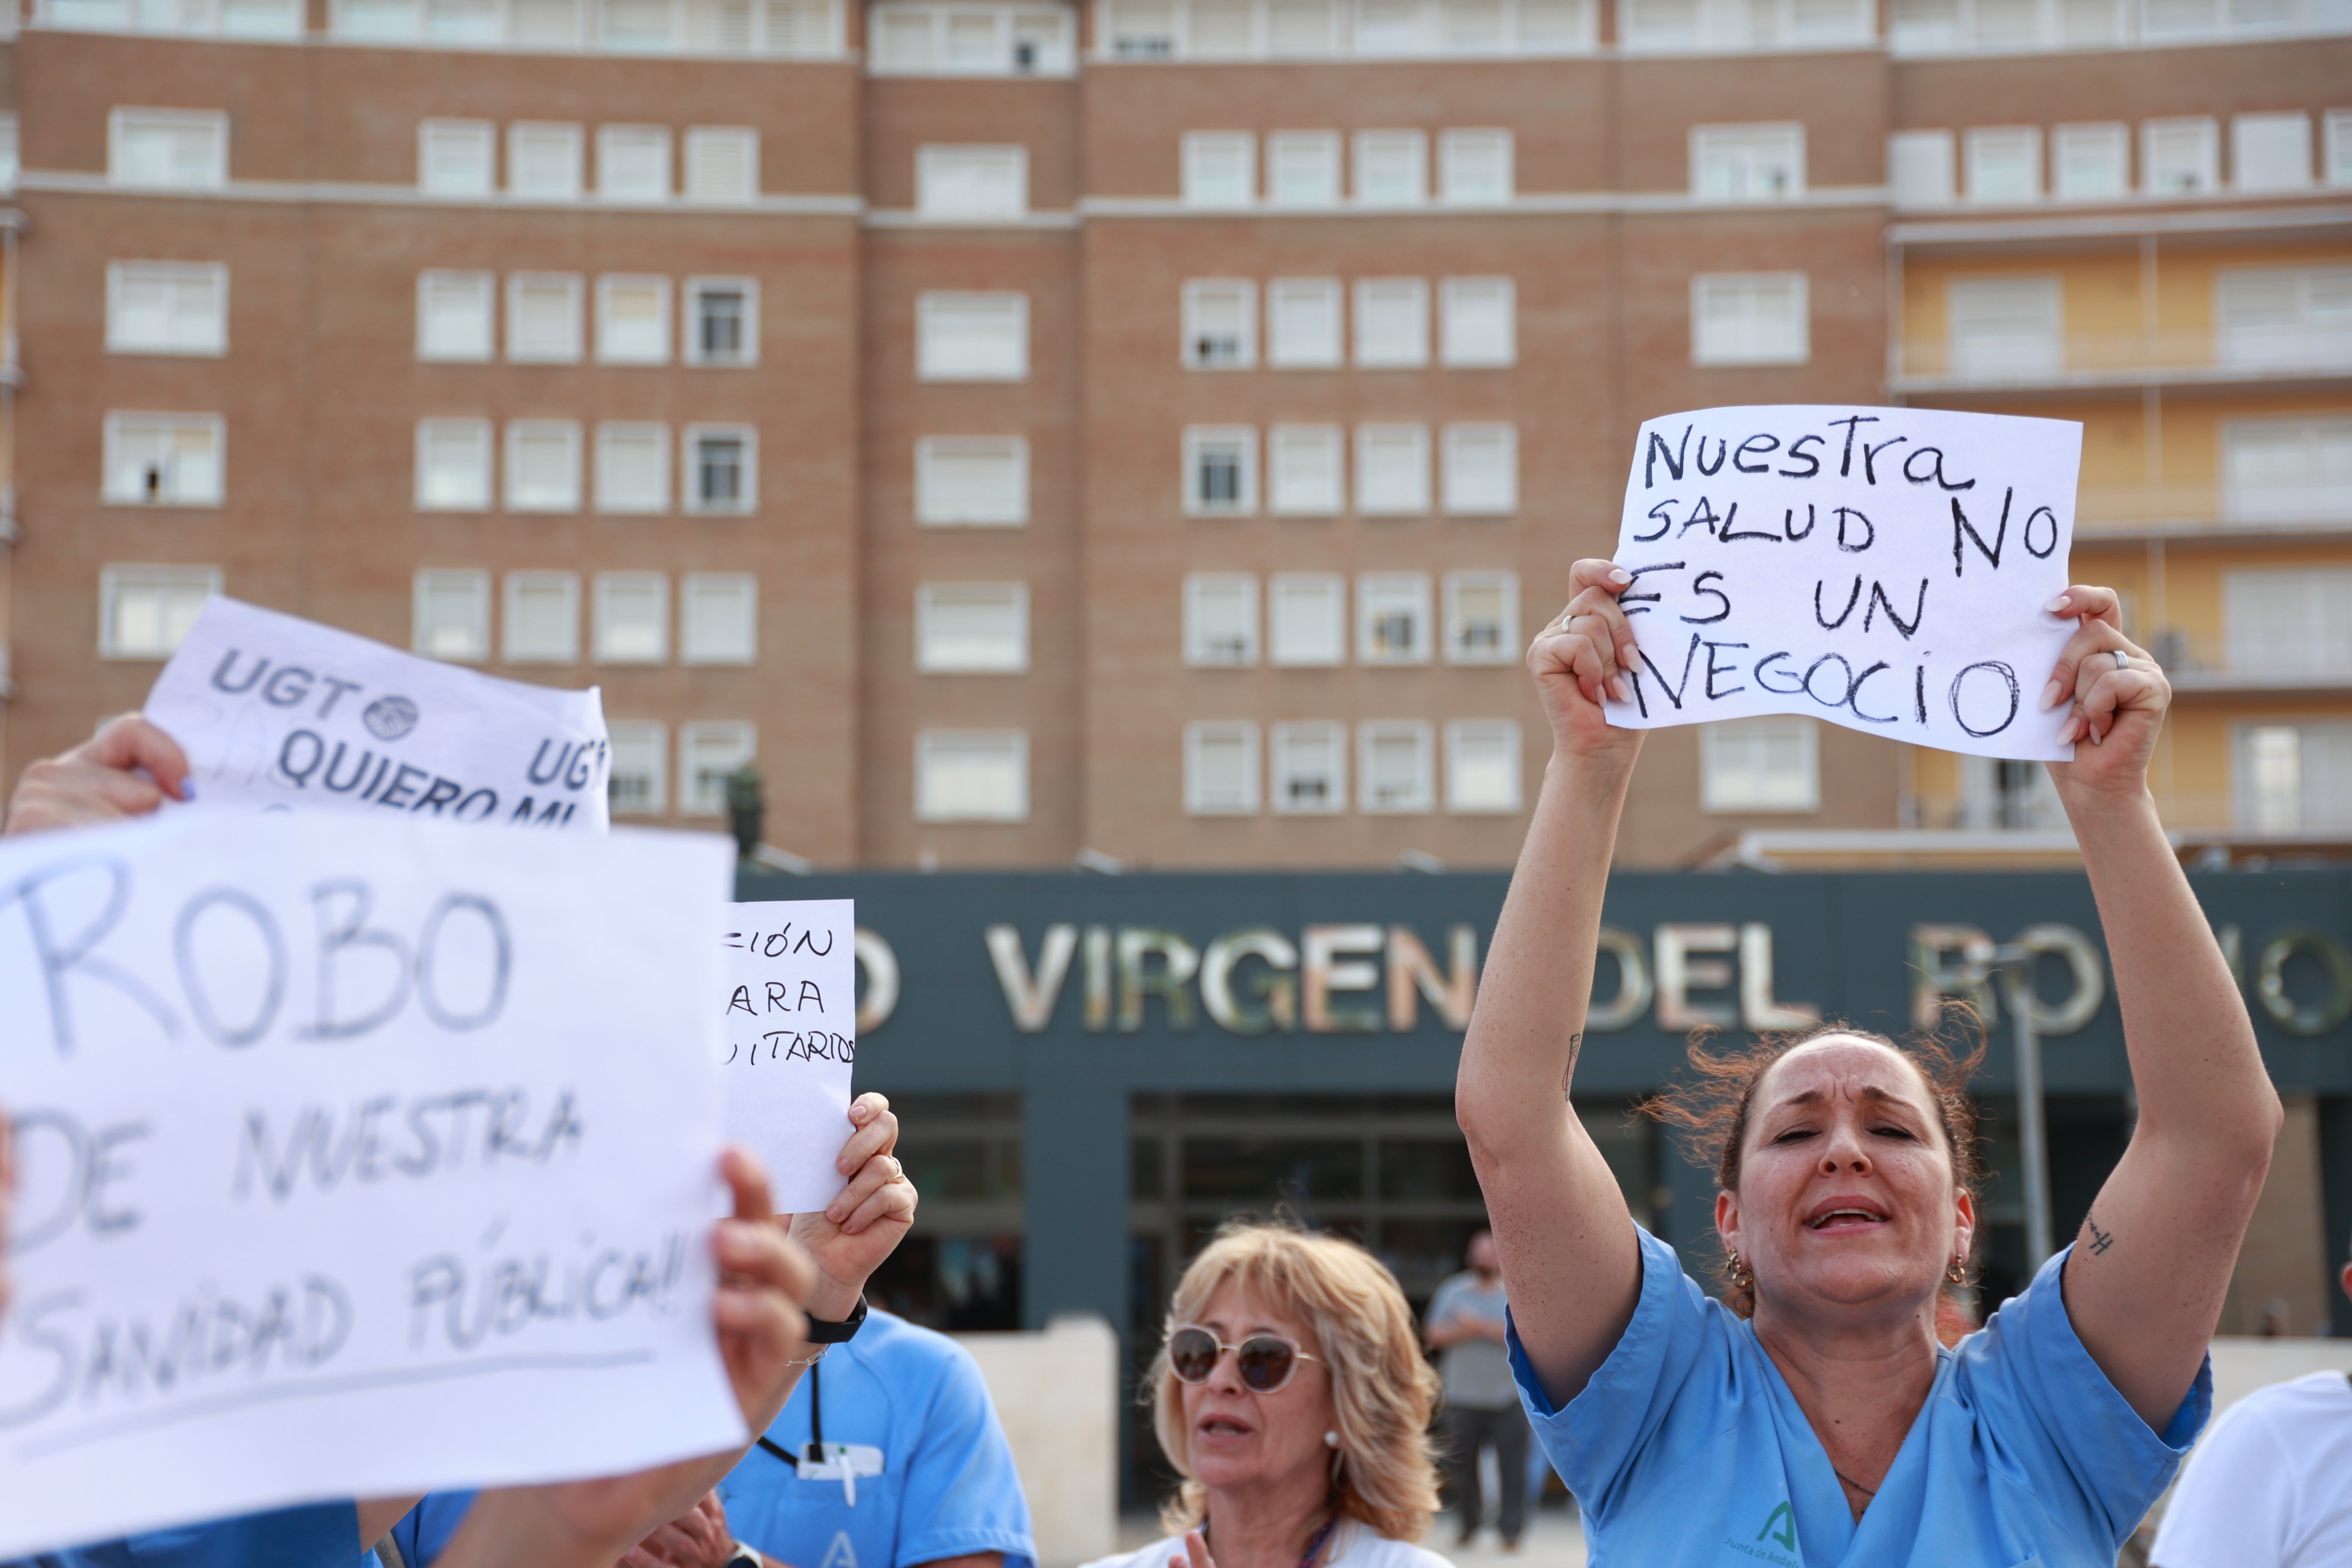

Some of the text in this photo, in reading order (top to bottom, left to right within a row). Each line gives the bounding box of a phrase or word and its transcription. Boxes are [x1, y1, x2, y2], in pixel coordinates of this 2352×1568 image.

[1633, 487, 2058, 577] SALUD NO
[1619, 561, 1928, 641] ES UN
[210, 647, 364, 720] UGT
[277, 728, 499, 822] QUIERO
[0, 853, 513, 1057] ROBO
[726, 980, 824, 1016] ARA
[983, 923, 1477, 1034] VIRGEN
[1583, 922, 1822, 1032] DEL
[2, 1106, 154, 1255] DE
[232, 1087, 585, 1204] NUESTRA
[0, 1272, 353, 1428] SANIDAD
[1724, 1537, 1753, 1555] Junta
[1755, 1548, 1766, 1559] de
